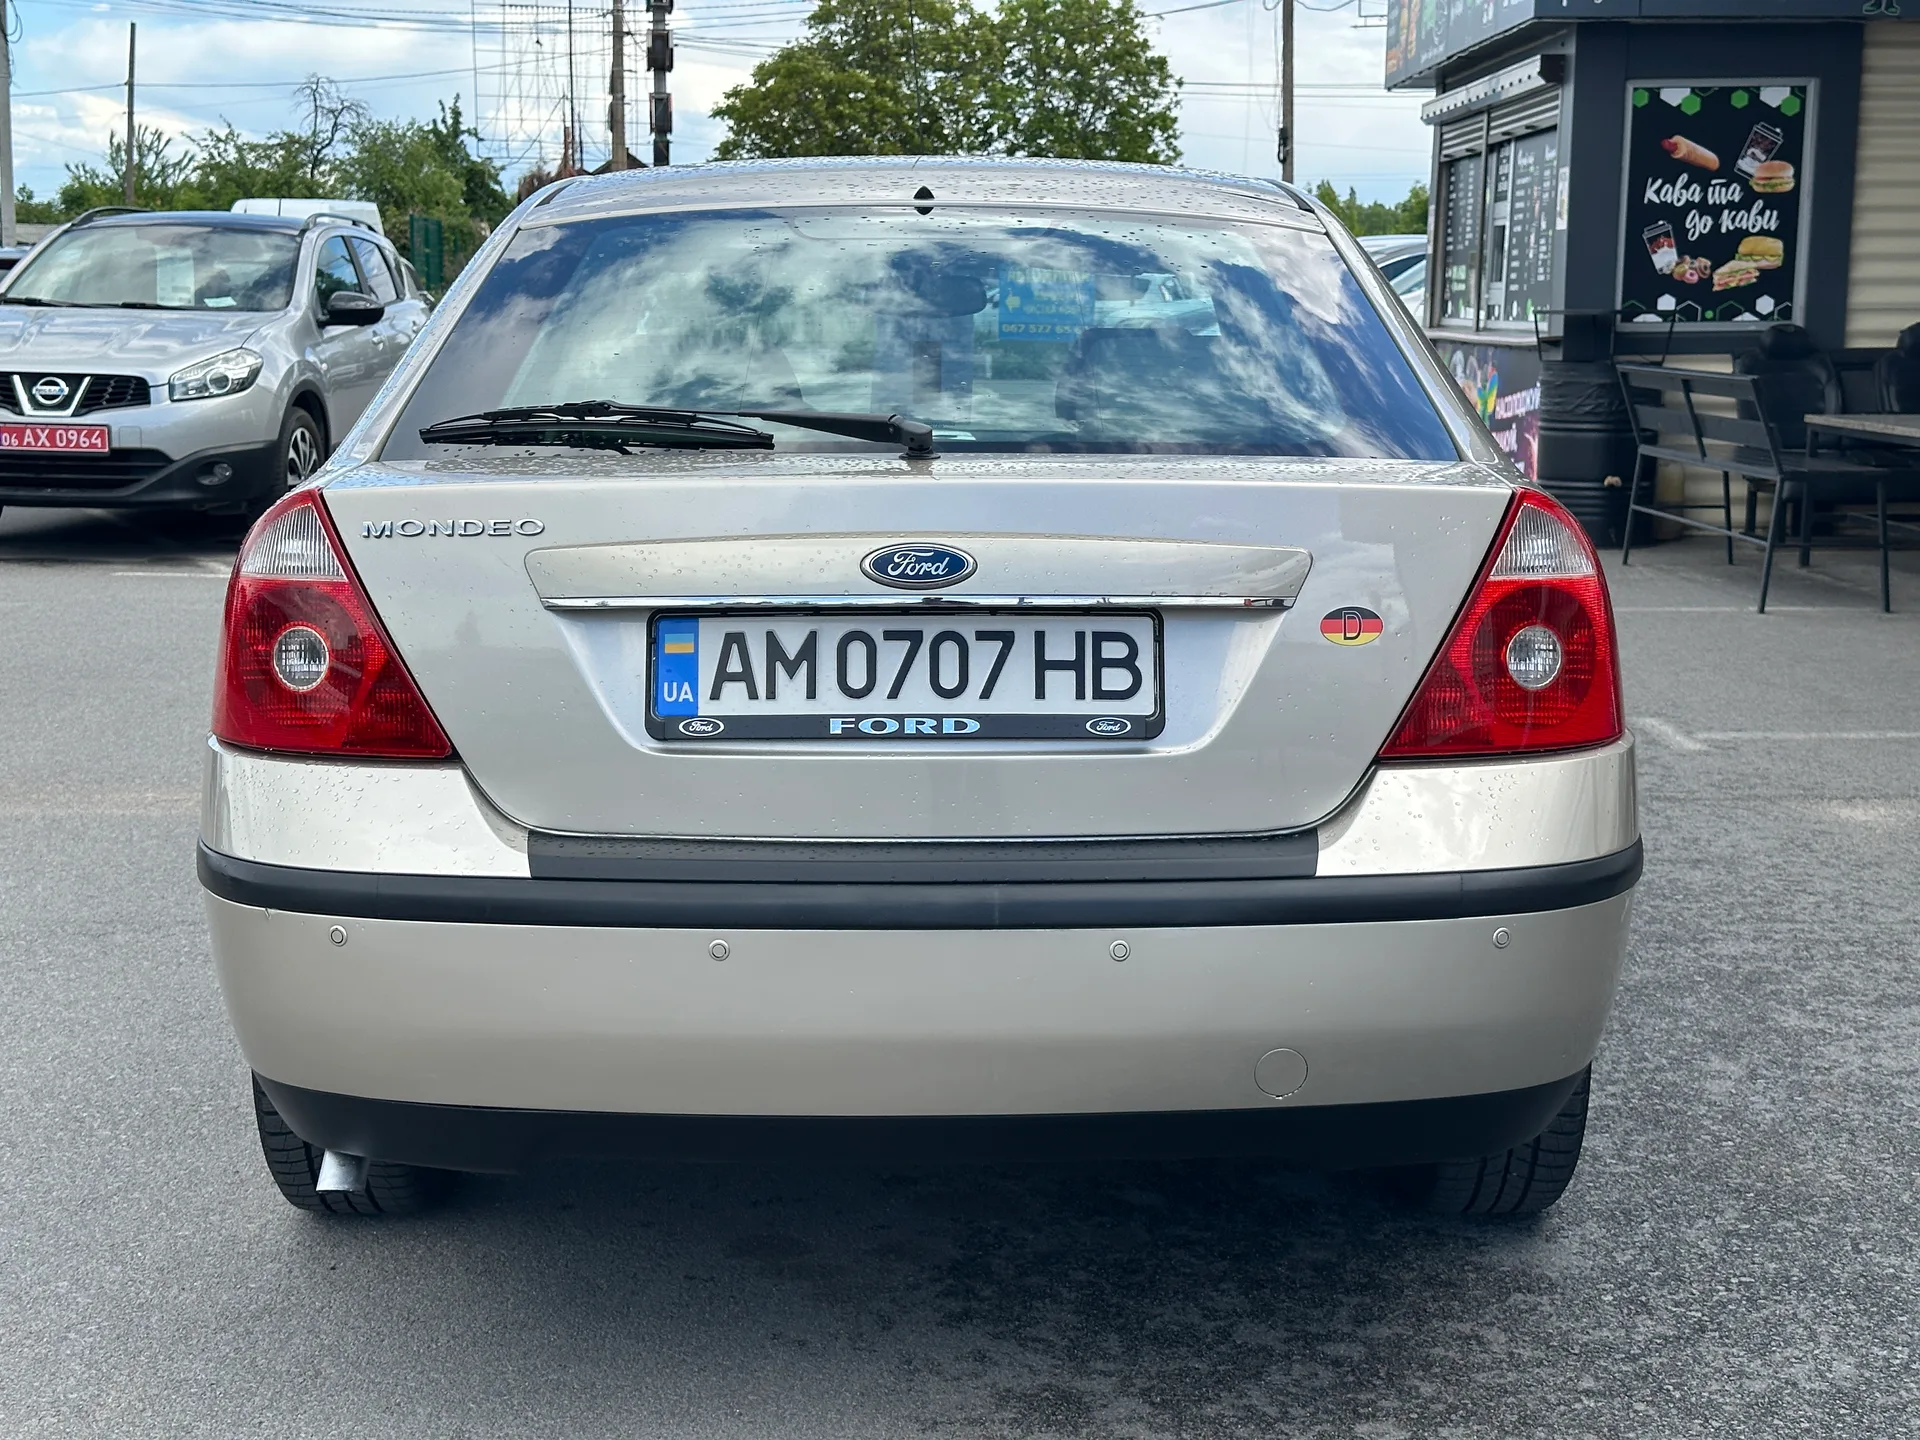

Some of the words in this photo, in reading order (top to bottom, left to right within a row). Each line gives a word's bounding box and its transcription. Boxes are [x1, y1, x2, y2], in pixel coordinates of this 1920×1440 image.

[1643, 172, 1704, 207] Кава
[1707, 178, 1744, 205] та
[1685, 209, 1714, 242] до
[1718, 199, 1780, 234] кави
[2, 432, 19, 446] 06
[23, 428, 51, 448] AX
[56, 429, 102, 448] 0964
[362, 518, 545, 539] MONDEO
[886, 550, 950, 577] Ford
[1342, 610, 1363, 641] D
[709, 630, 819, 701] AM
[836, 630, 1016, 700] 0707
[1034, 630, 1143, 701] HB
[663, 681, 694, 702] UA
[688, 720, 714, 733] Ford
[829, 717, 981, 735] FORD
[1096, 720, 1121, 732] Ford
